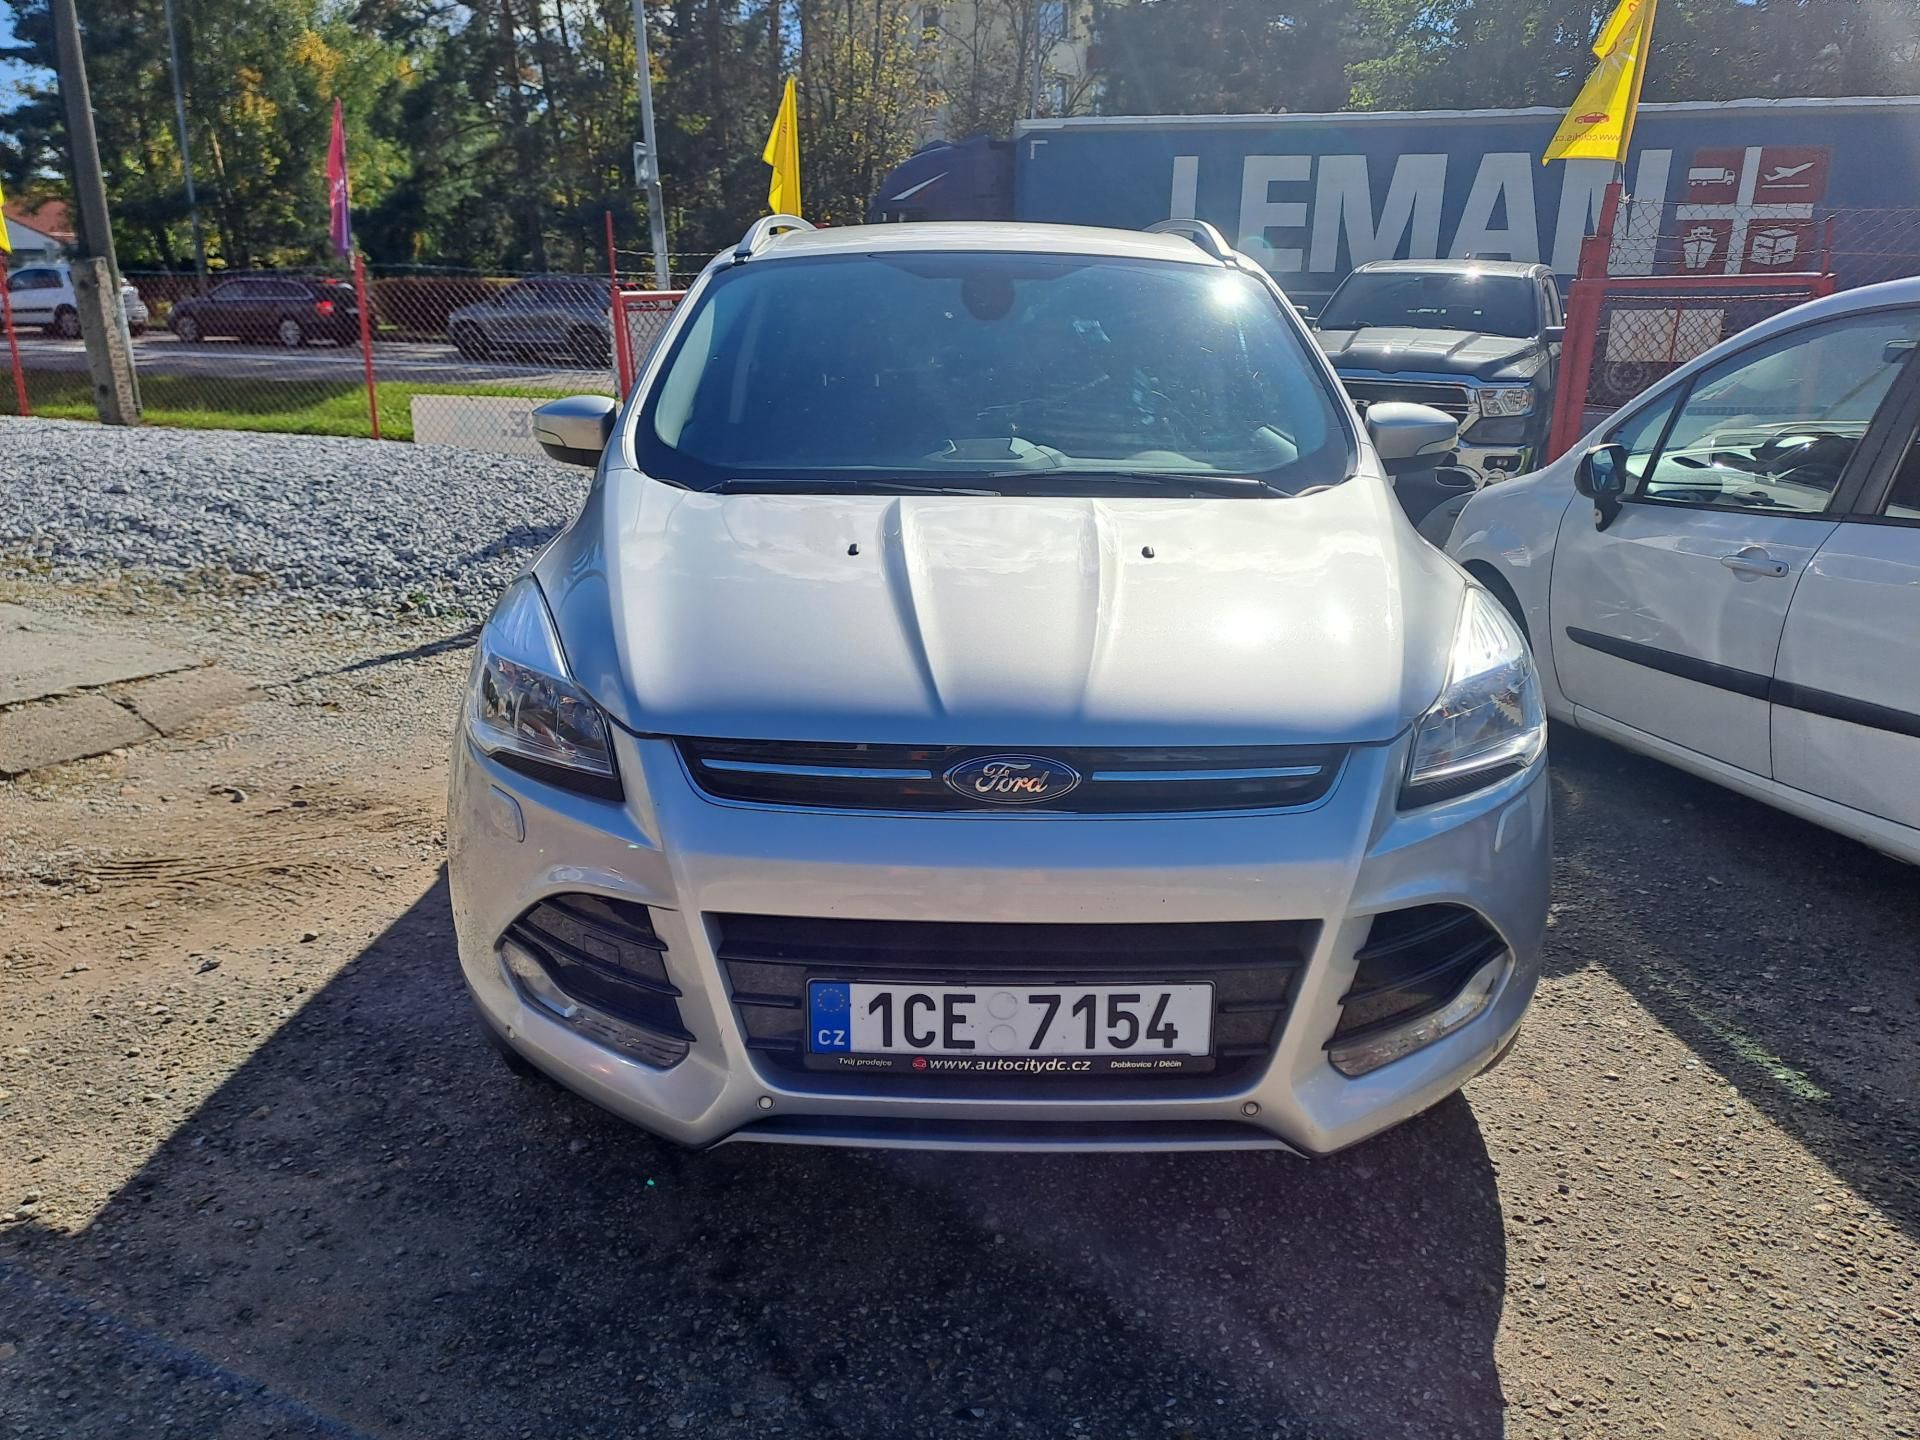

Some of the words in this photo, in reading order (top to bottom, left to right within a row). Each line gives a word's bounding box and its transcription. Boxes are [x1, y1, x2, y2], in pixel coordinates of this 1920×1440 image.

[975, 761, 1050, 793] Ford
[867, 992, 977, 1050] 1CE
[1027, 992, 1179, 1050] 7154
[817, 1029, 846, 1046] CZ
[857, 1057, 893, 1067] prodejce
[929, 1057, 1092, 1074] www.autocitydc.cz
[1110, 1060, 1152, 1069] Dobkovice
